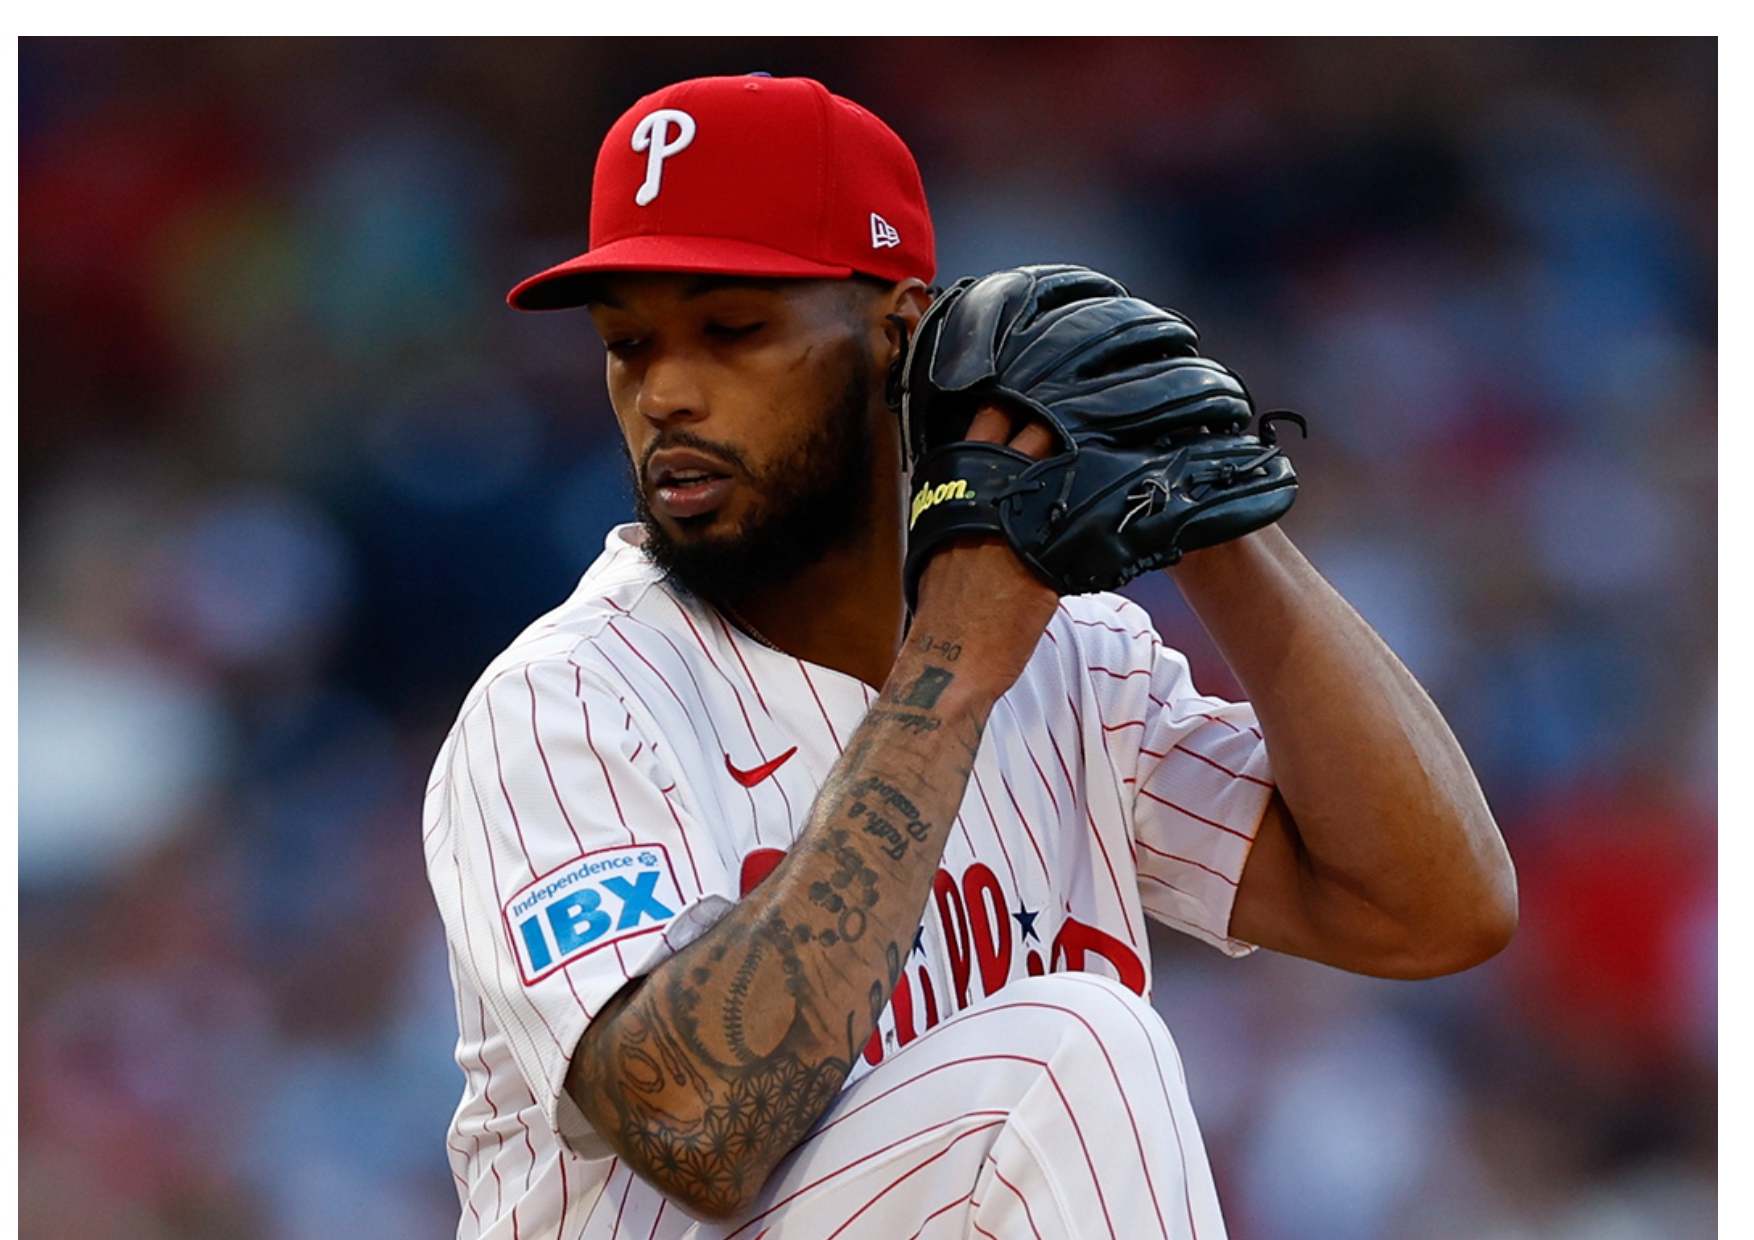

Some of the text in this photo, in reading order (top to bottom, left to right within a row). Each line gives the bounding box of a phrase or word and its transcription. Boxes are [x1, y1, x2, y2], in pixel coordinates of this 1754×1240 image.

[630, 108, 697, 207] P
[512, 854, 634, 918] Independence
[519, 871, 676, 973] IBX
